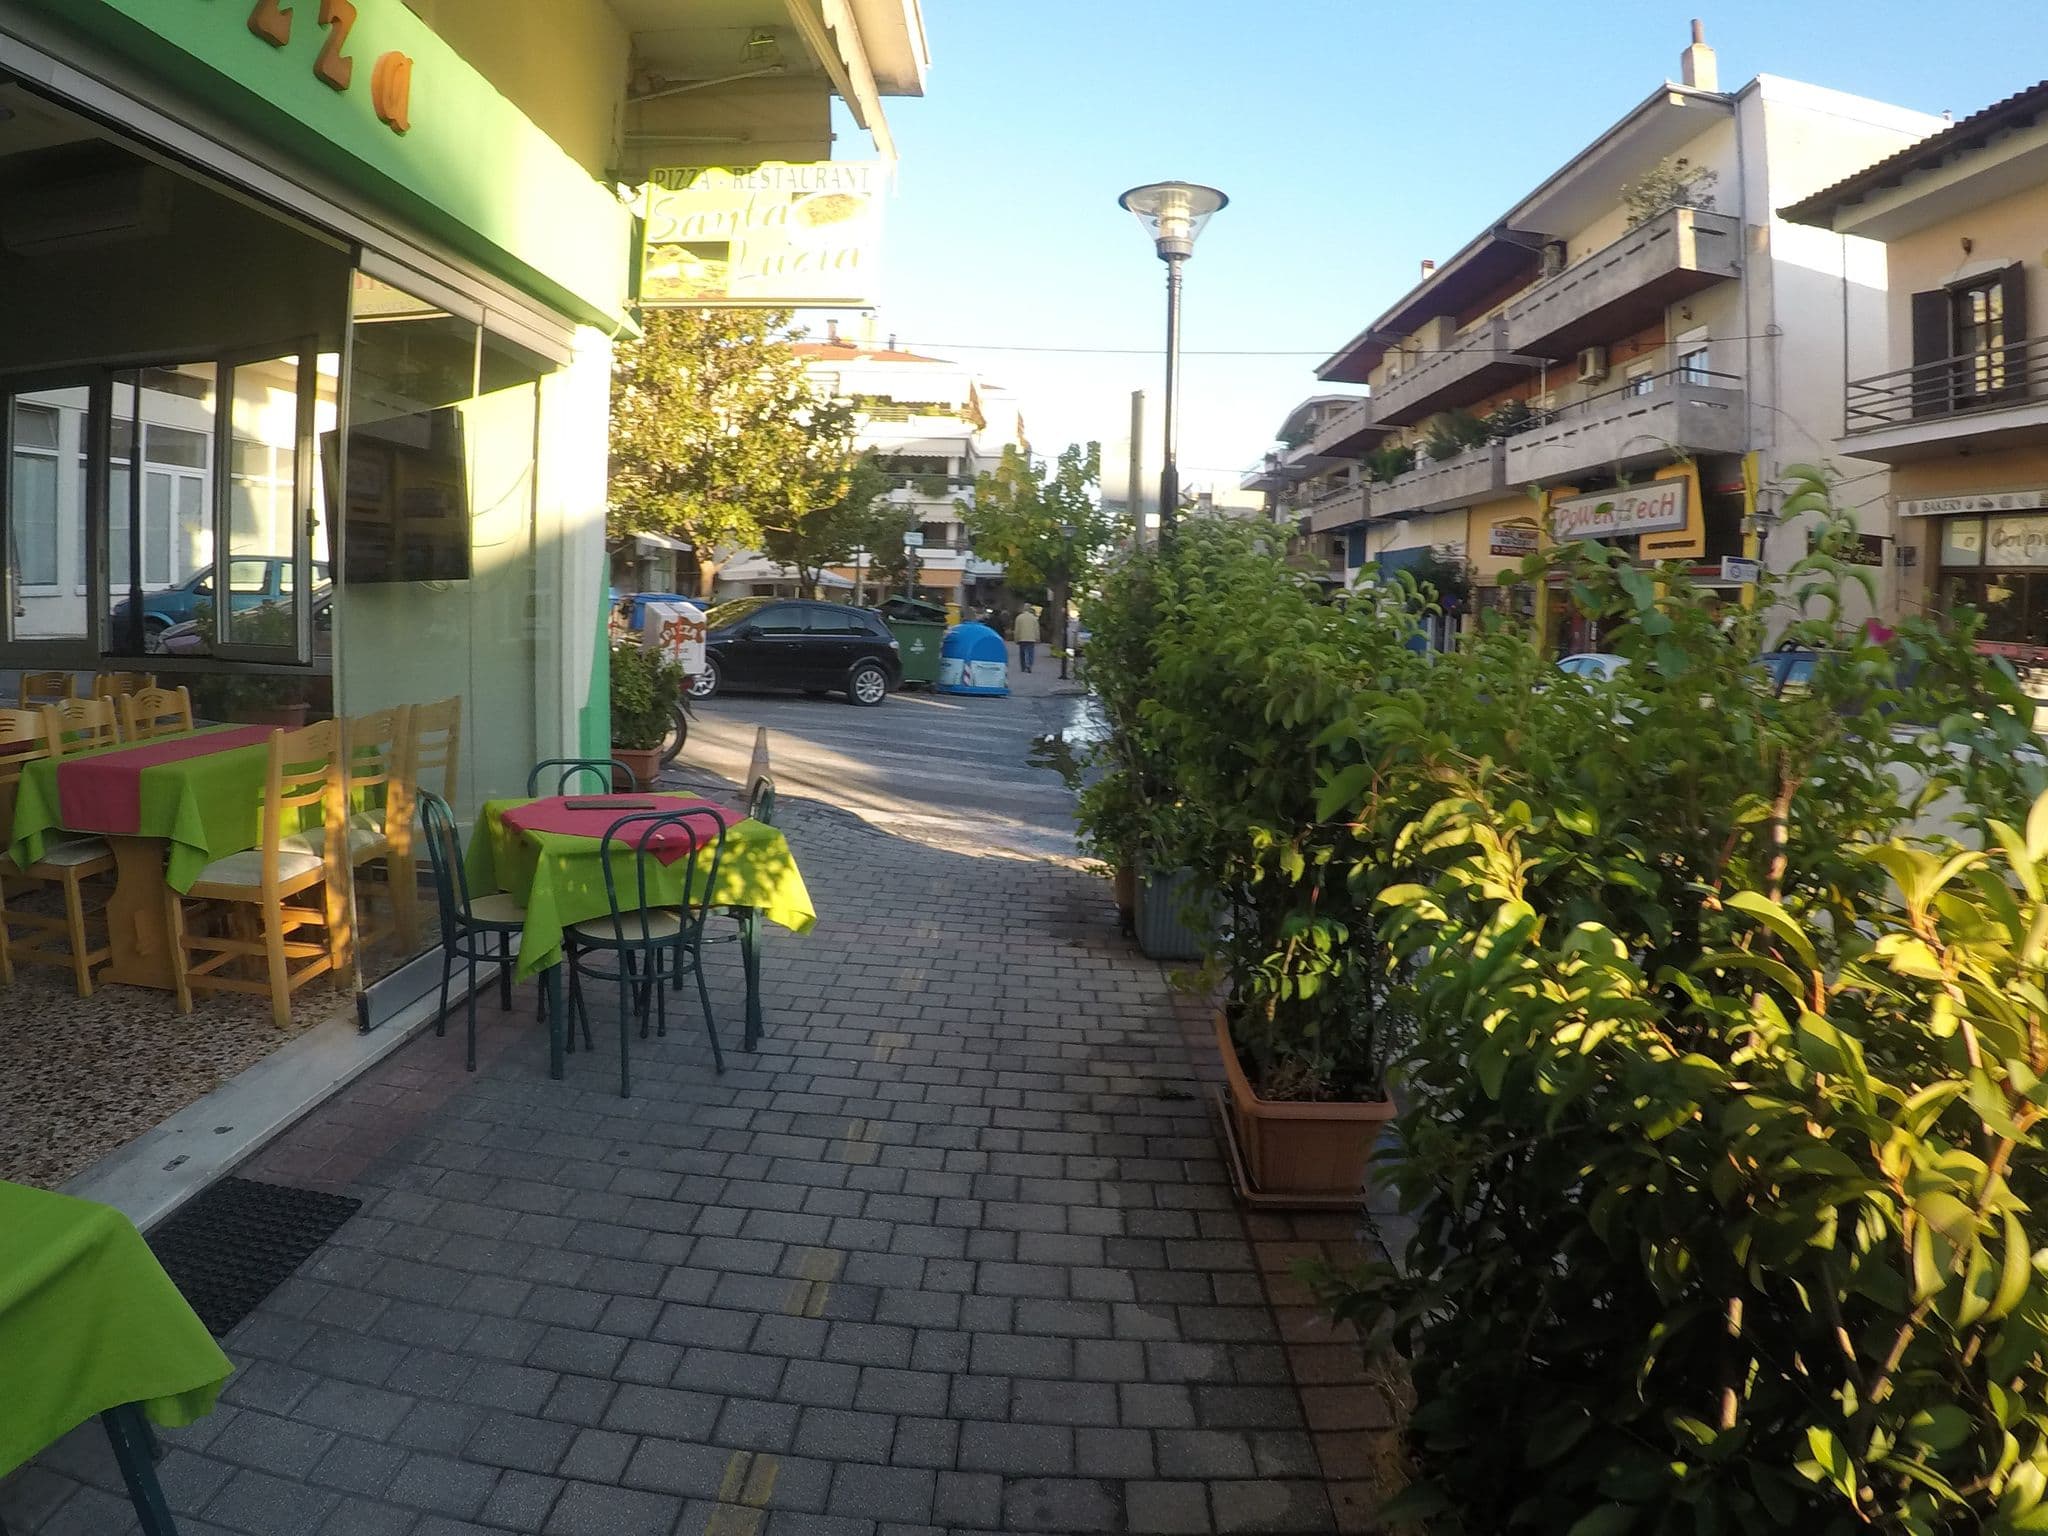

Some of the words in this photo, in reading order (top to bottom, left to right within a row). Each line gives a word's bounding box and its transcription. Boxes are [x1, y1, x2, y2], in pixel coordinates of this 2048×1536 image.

[654, 167, 711, 191] PIZZA
[733, 166, 870, 190] RESTAURANT
[651, 194, 788, 240] Santa
[737, 239, 860, 280] Lucia
